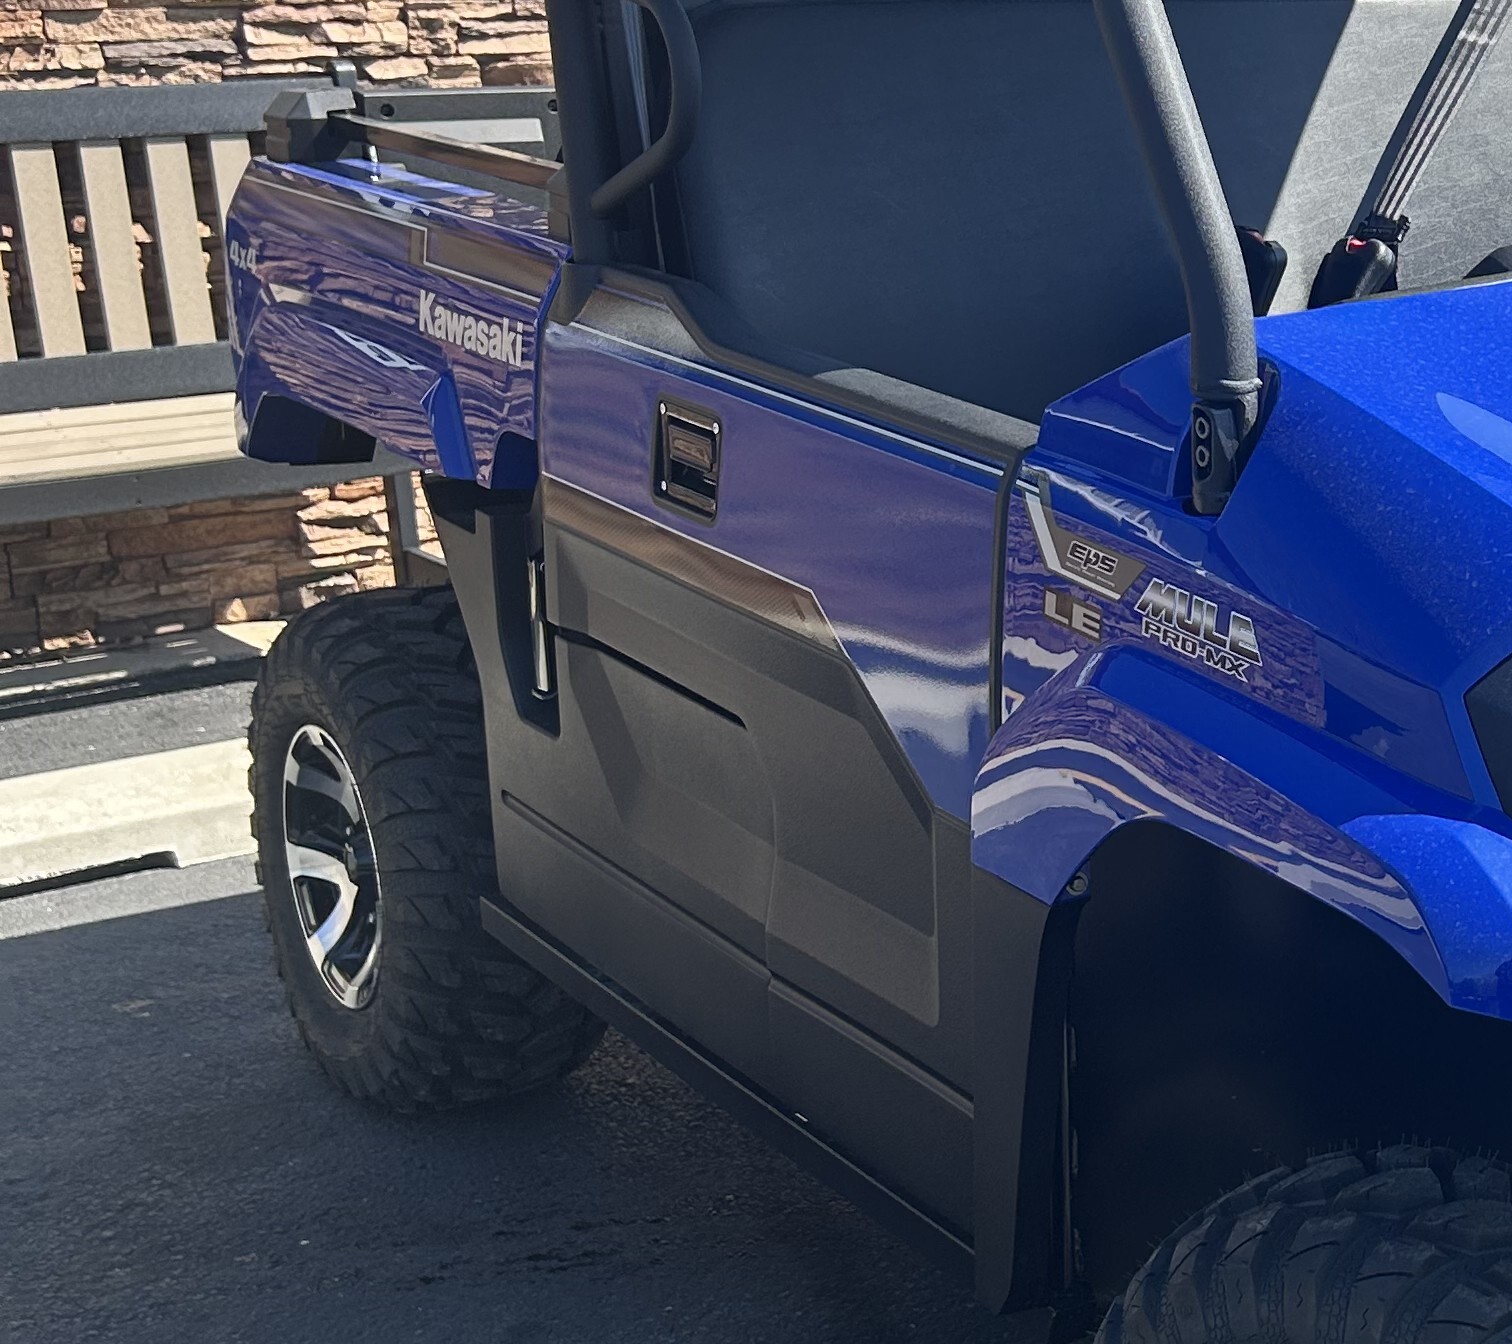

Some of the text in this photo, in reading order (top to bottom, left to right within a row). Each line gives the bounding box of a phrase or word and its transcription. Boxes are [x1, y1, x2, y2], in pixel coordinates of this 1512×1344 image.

[418, 289, 524, 366] Kawasaki
[1044, 588, 1101, 639] LE
[1134, 577, 1263, 666] MULE
[1142, 616, 1250, 683] PRO-MX
